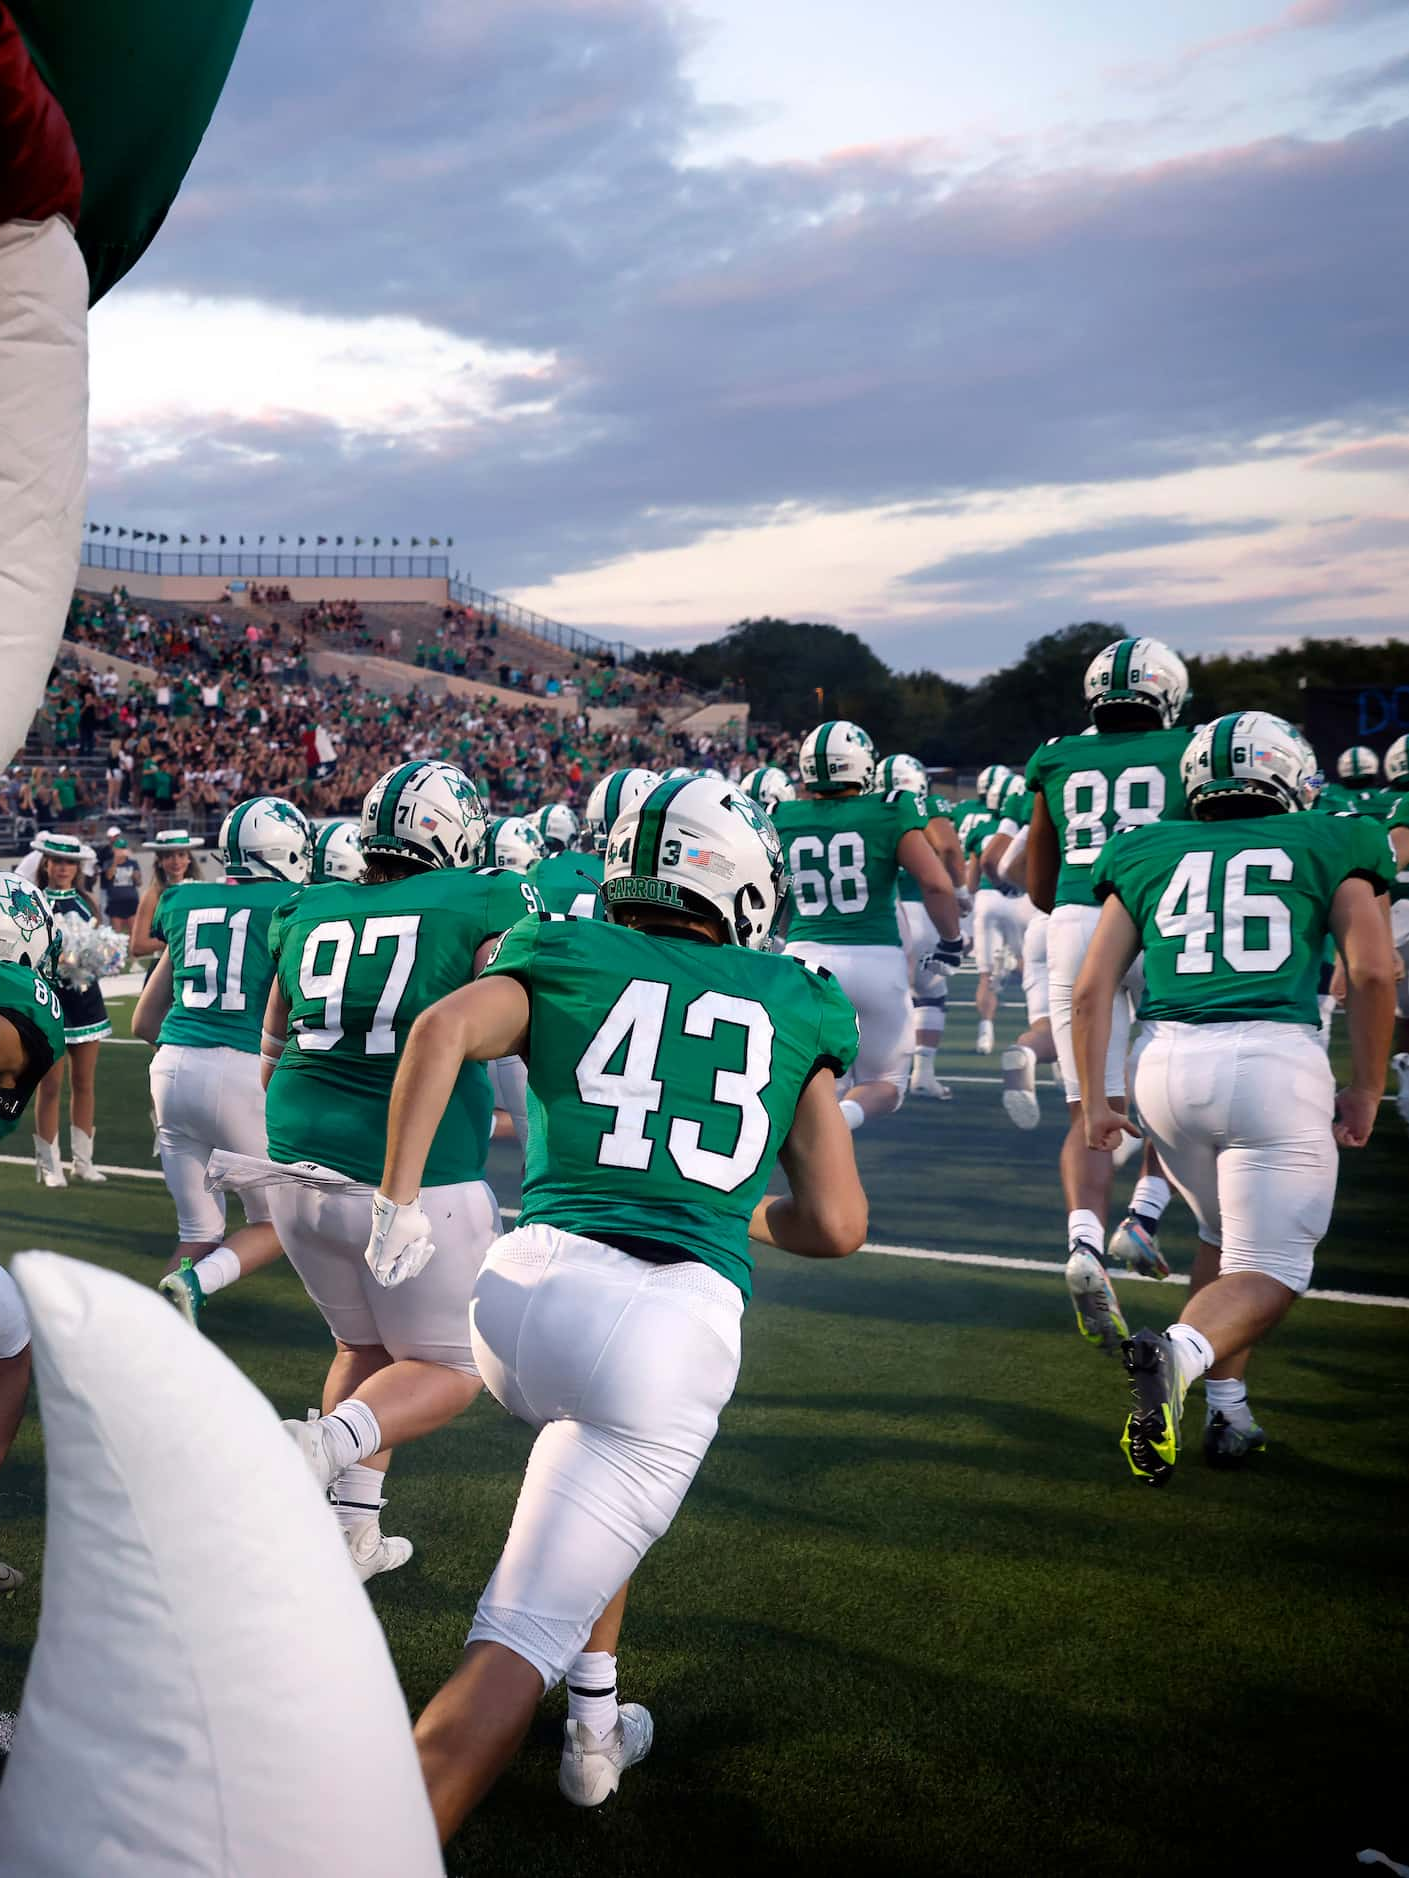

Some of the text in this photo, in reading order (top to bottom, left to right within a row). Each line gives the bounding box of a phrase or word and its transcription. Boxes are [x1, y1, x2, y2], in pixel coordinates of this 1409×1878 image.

[1131, 669, 1140, 683] 8
[1234, 747, 1246, 763] 6
[369, 803, 409, 824] 9 7
[1064, 766, 1165, 865] 88
[619, 838, 682, 866] 4 3
[790, 831, 869, 915] 68
[607, 879, 684, 907] CARROLL
[1155, 848, 1293, 974] 46
[182, 908, 246, 1011] 51
[294, 915, 420, 1055] 97
[34, 977, 62, 1020] 80
[575, 979, 775, 1193] 43
